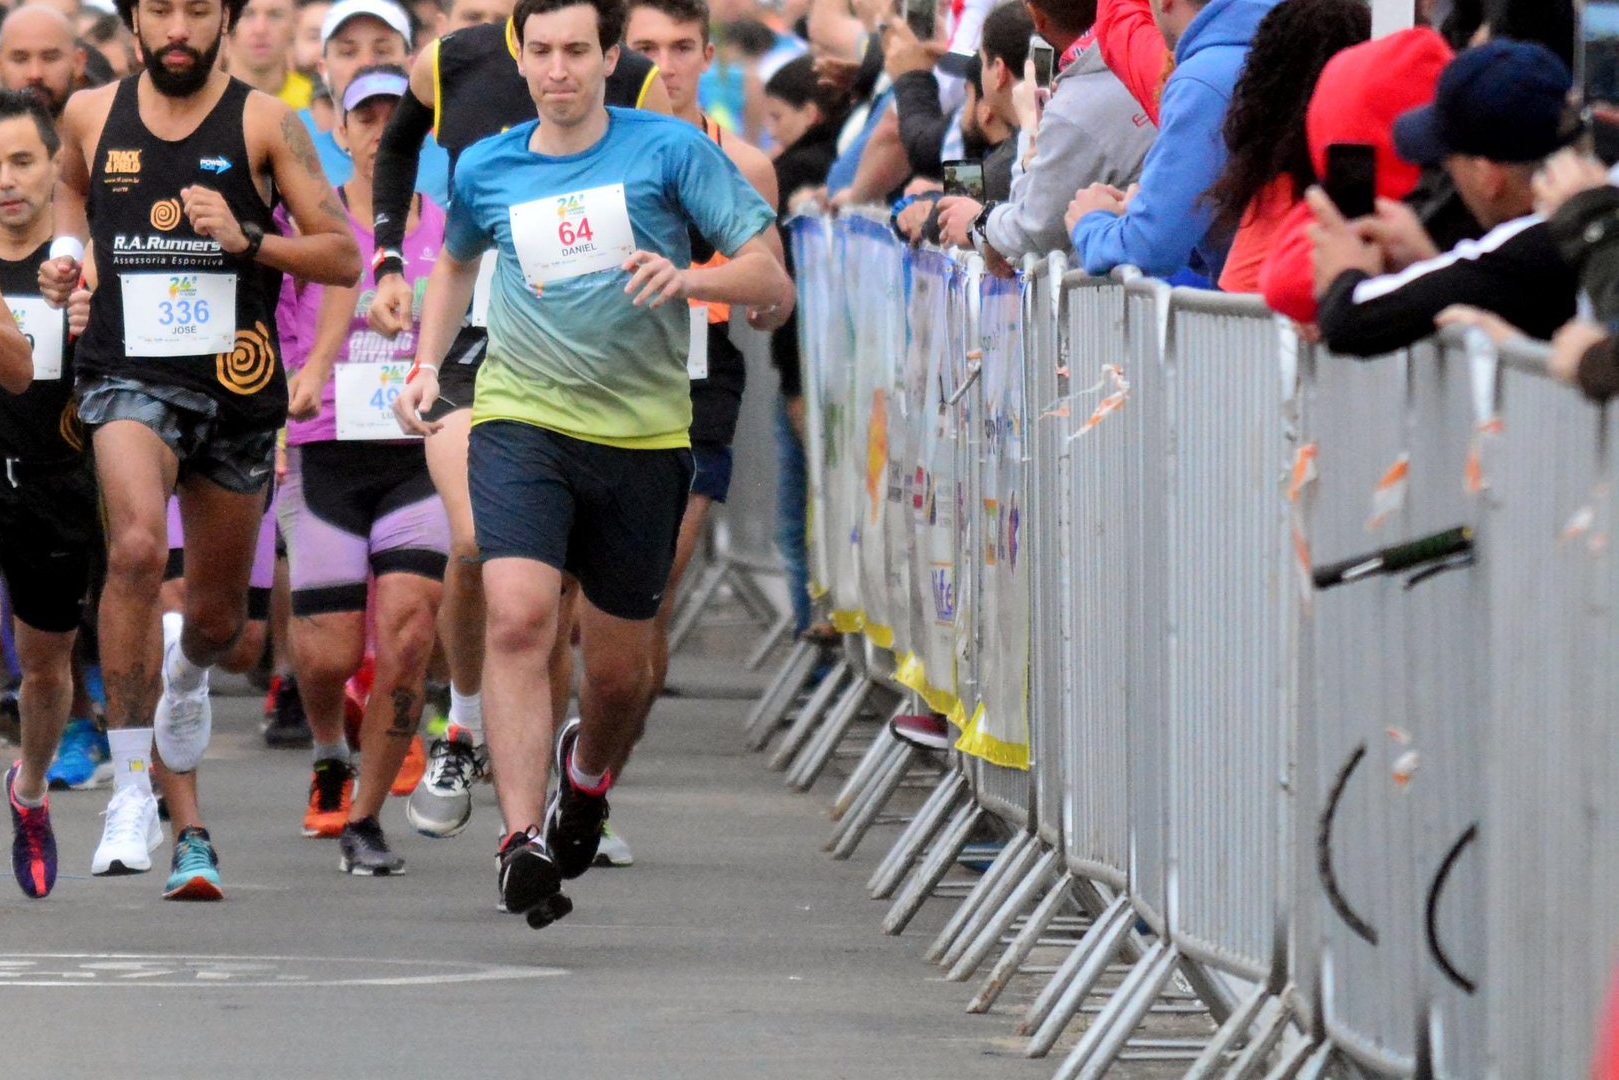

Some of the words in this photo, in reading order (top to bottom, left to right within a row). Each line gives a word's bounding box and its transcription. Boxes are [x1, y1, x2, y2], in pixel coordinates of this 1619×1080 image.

[107, 150, 141, 162] TRACK
[558, 216, 594, 247] 64
[113, 235, 222, 252] R.A.Runners
[561, 242, 598, 257] DANIEL
[113, 256, 167, 266] Assessoria
[171, 256, 224, 267] Esportiva
[157, 299, 210, 326] 336
[171, 323, 198, 335] JOSÉ
